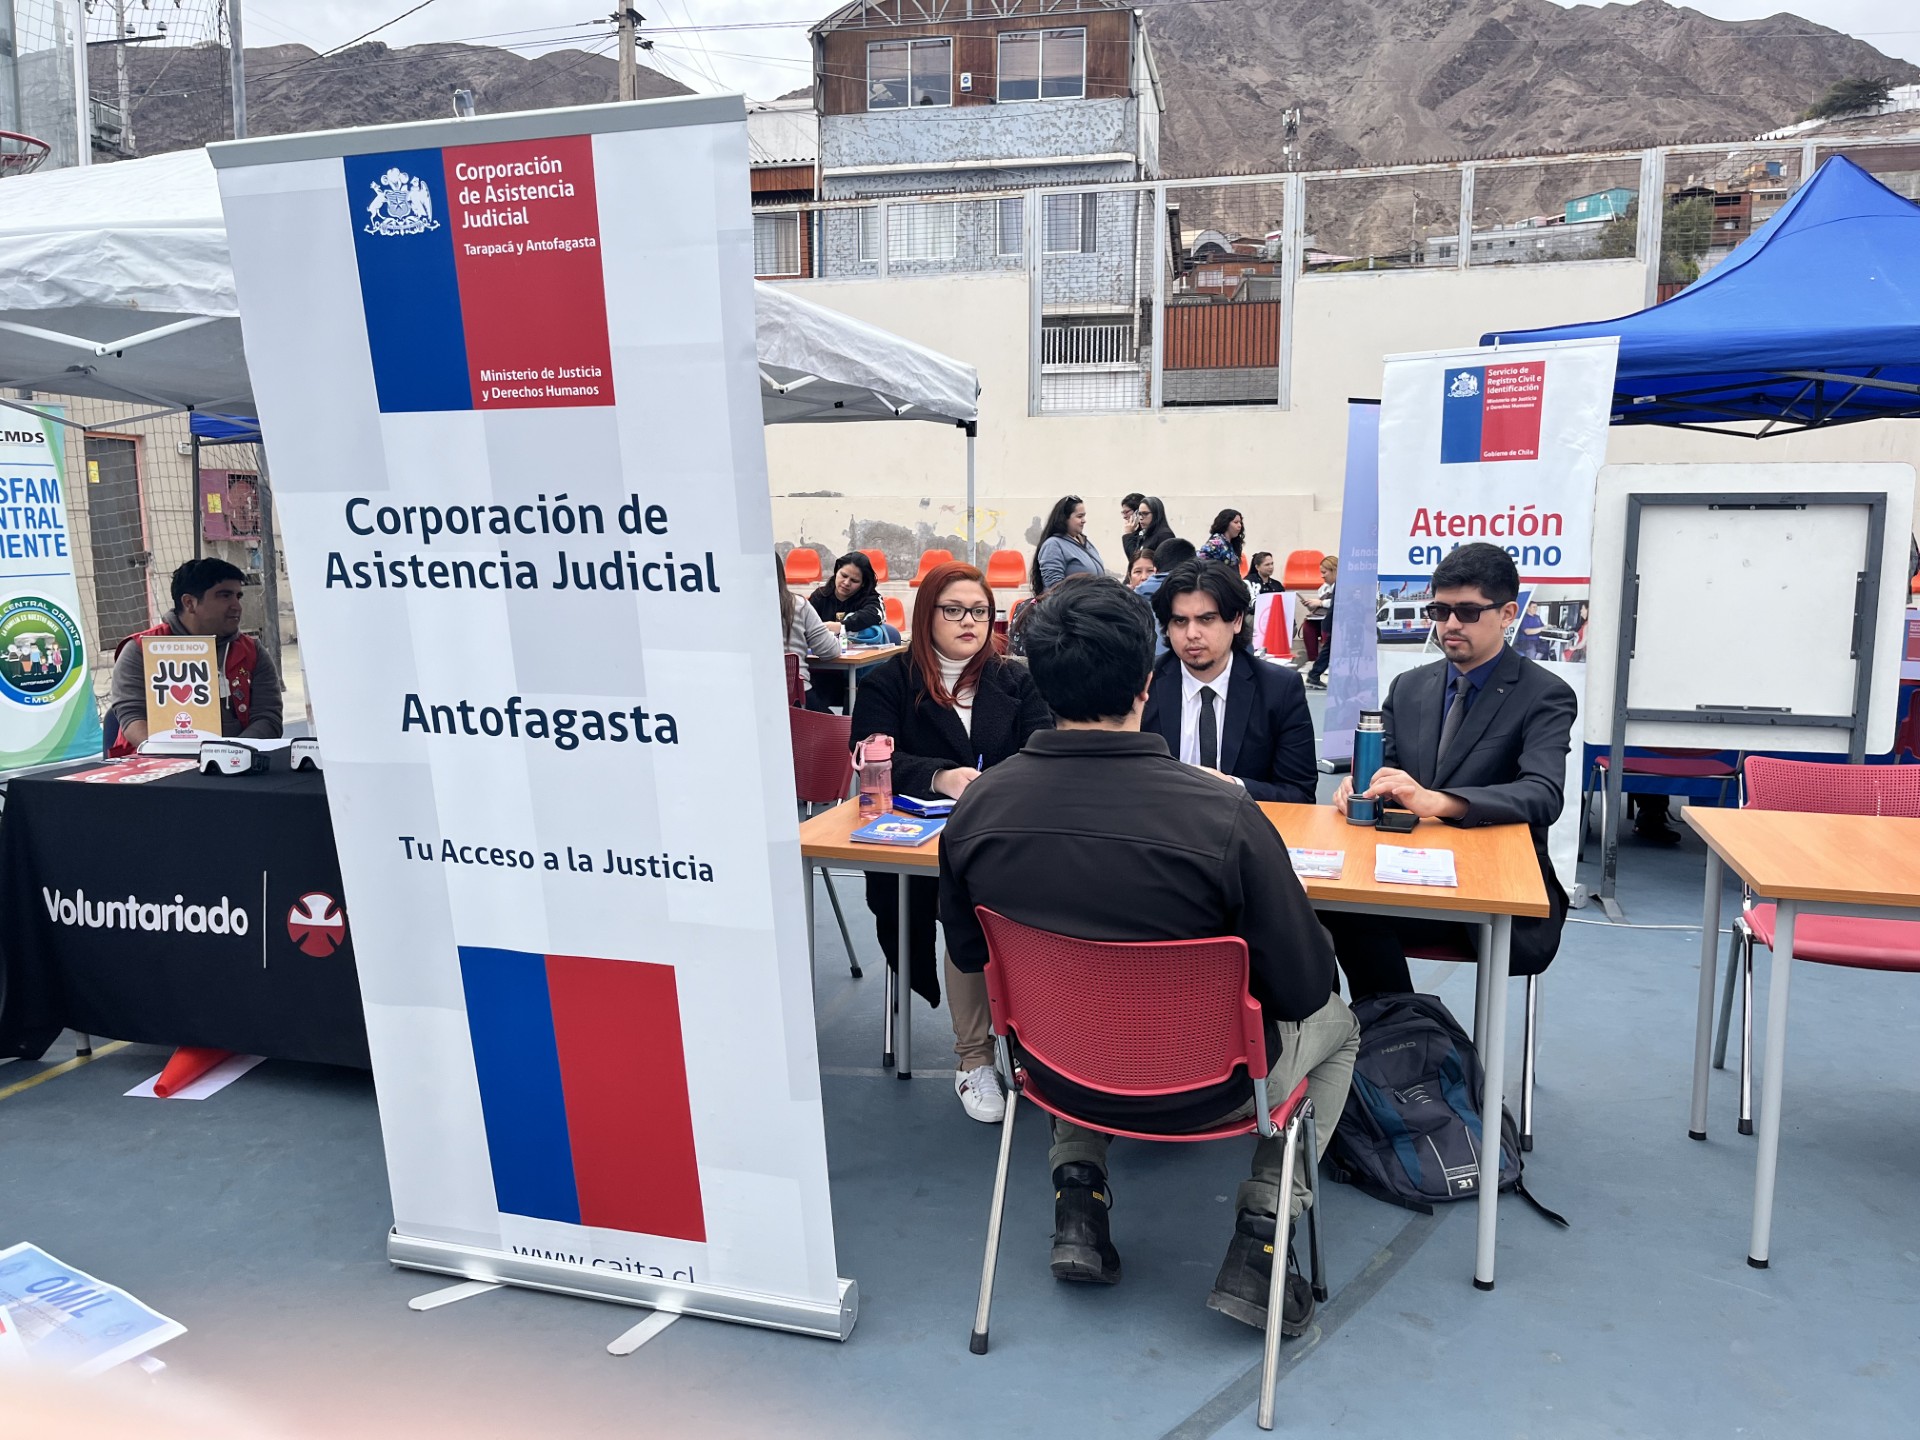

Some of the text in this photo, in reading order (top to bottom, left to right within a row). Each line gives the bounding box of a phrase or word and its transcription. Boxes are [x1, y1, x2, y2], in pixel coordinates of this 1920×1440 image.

[456, 156, 562, 183] Corporación
[458, 180, 574, 204] de Asistencia
[462, 206, 529, 228] Judicial
[464, 237, 596, 256] Tarapacá y Antofagasta
[480, 366, 602, 382] Ministerio de Justicia
[1487, 377, 1517, 386] Registro
[1518, 375, 1535, 383] Civil
[1488, 368, 1517, 376] Servicio
[482, 385, 599, 402] y Derechos Humanos
[1487, 384, 1539, 394] Identificación
[345, 492, 668, 544] Corporación de
[1410, 504, 1563, 536] Atención
[1408, 545, 1442, 565] en
[326, 550, 721, 593] Asistencia Judicial
[3, 600, 80, 646] CENTRAL ORIENTE
[153, 662, 208, 683] JUN
[24, 694, 56, 703] CMDS
[402, 693, 678, 750] Antofagasta
[398, 836, 713, 882] Tu Acceso a la Justicia
[42, 886, 249, 936] Voluntariado
[1381, 1041, 1417, 1055] HEAD
[1458, 1178, 1473, 1189] 31
[25, 1276, 112, 1318] OMIL
